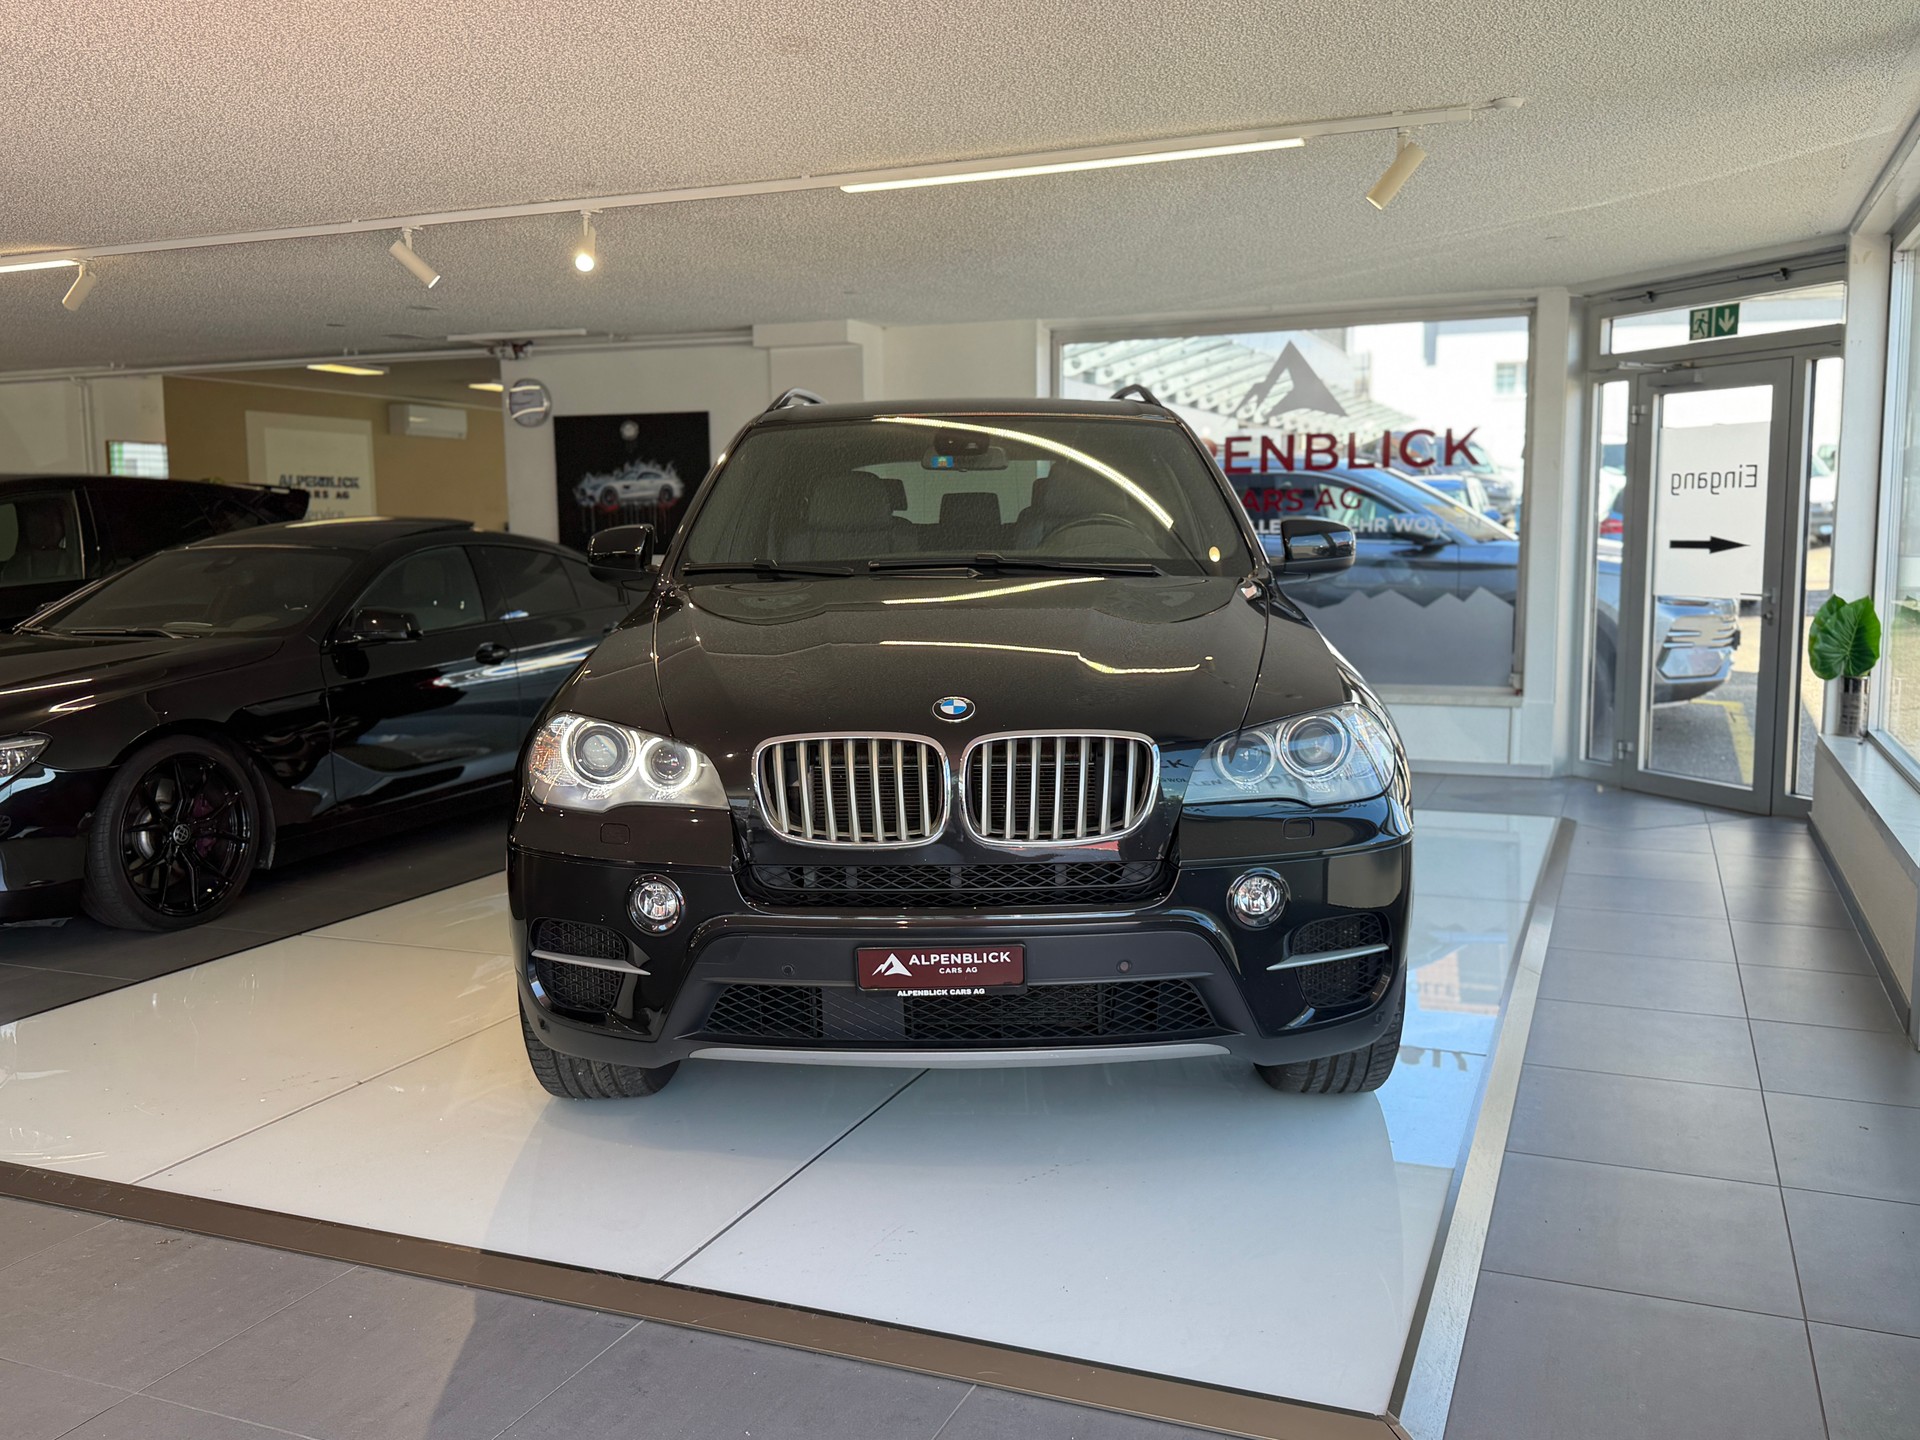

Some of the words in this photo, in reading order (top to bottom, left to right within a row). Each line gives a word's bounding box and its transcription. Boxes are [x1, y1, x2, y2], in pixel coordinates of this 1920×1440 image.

[1241, 488, 1304, 513] ARS
[1314, 486, 1363, 511] AG
[1250, 518, 1281, 535] LLE
[1351, 517, 1388, 534] EHR
[908, 951, 1012, 966] ALPENBLICK
[965, 966, 978, 974] AG
[897, 988, 949, 997] ALPENBLICK
[949, 987, 972, 996] CARS
